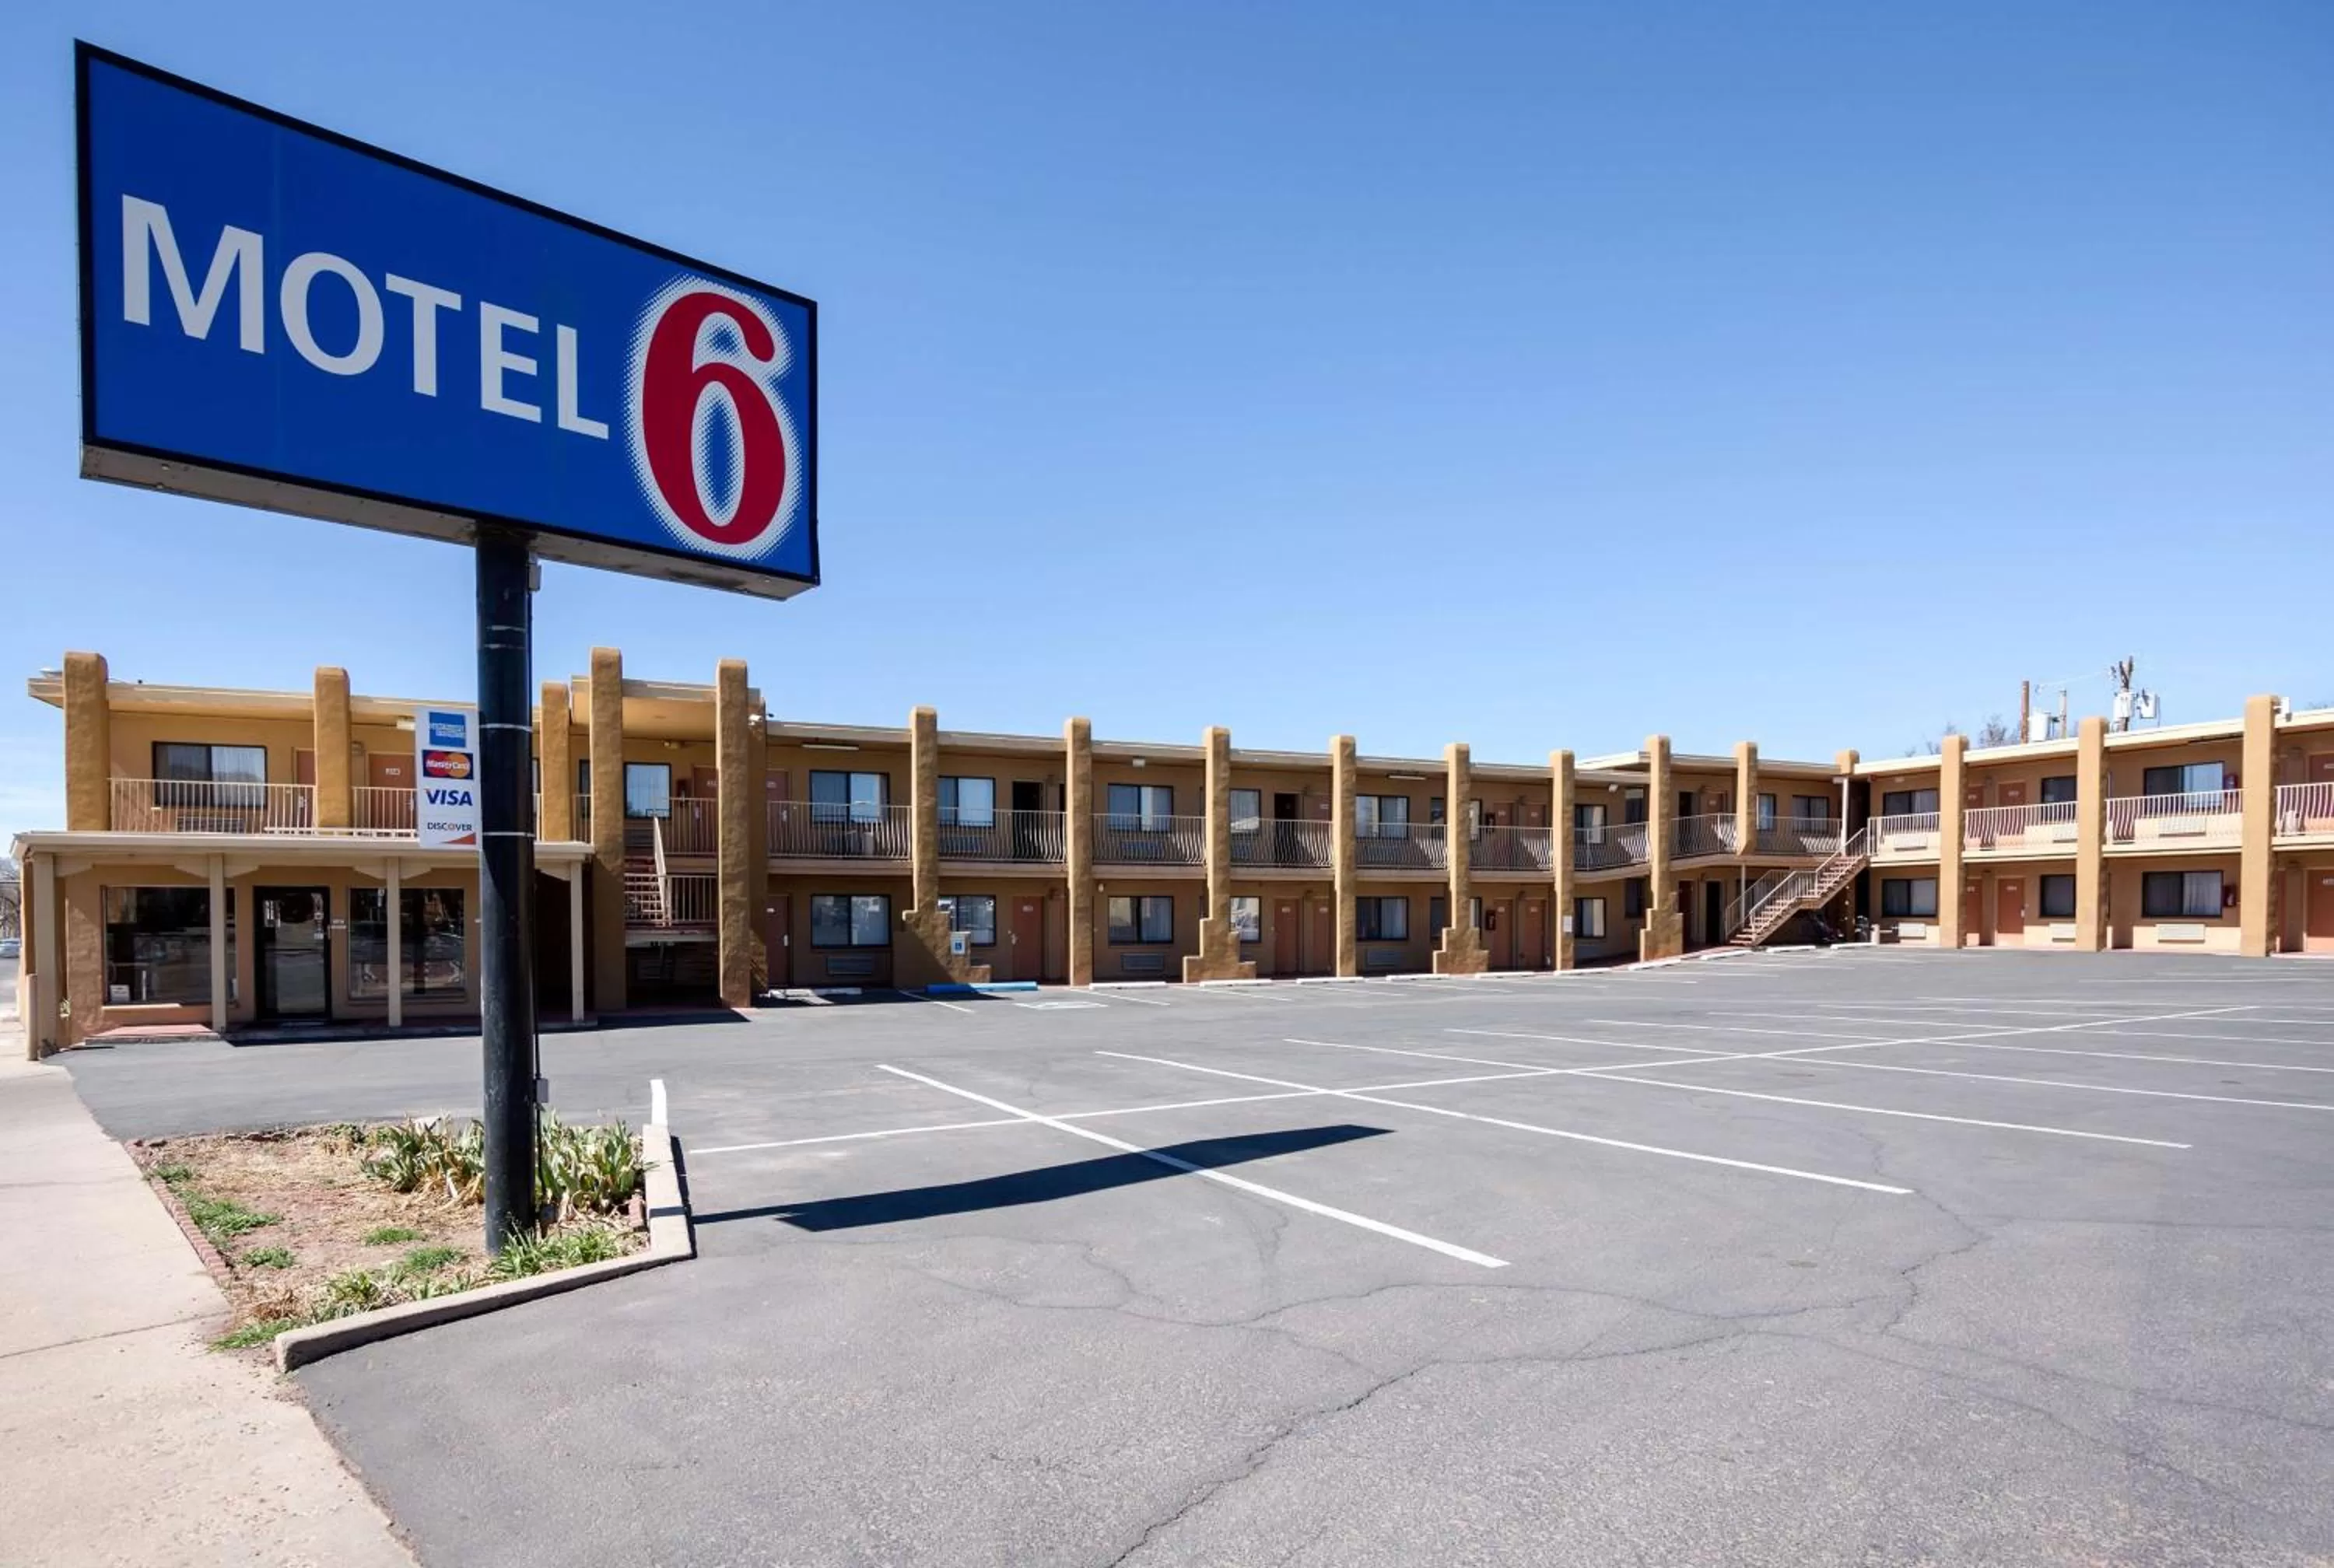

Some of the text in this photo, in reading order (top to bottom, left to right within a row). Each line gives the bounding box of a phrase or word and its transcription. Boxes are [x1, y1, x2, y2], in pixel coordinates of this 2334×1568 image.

[121, 194, 786, 545] MOTEL 6
[426, 789, 473, 807] VISA
[427, 822, 472, 831] DISCOVER
